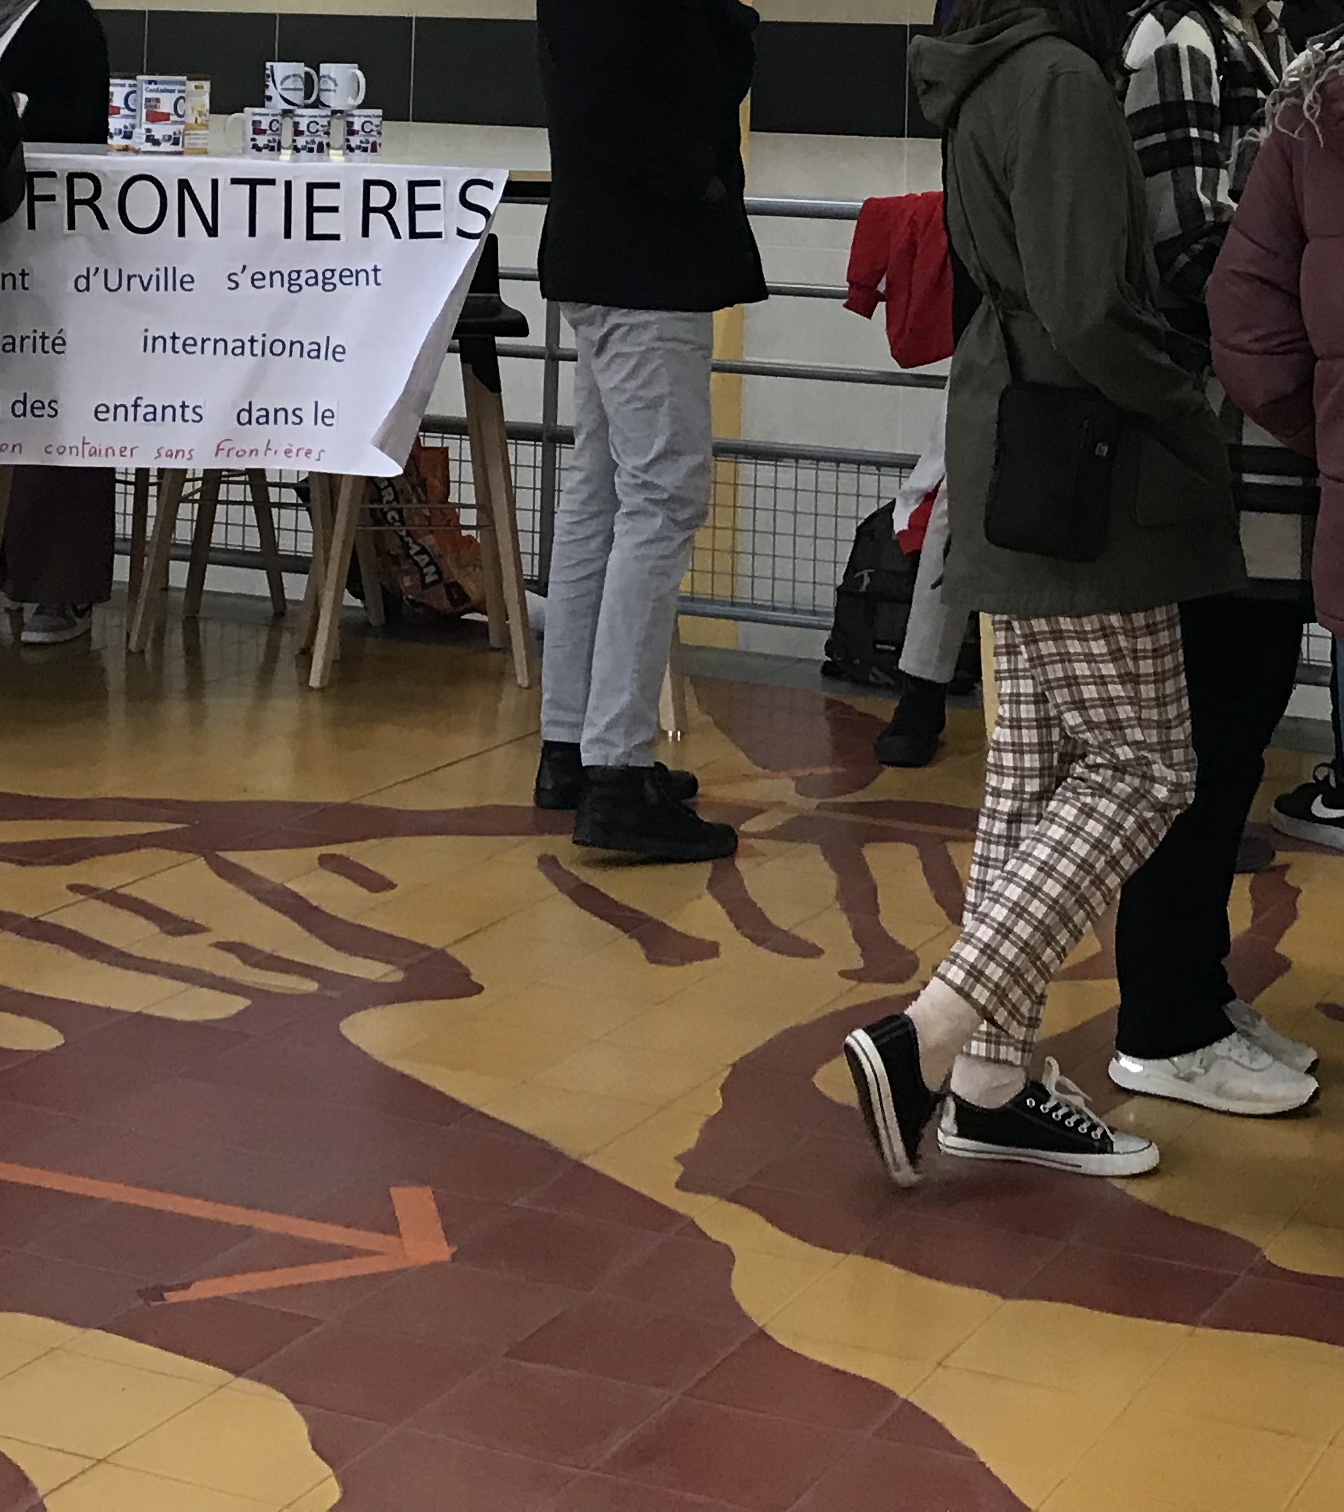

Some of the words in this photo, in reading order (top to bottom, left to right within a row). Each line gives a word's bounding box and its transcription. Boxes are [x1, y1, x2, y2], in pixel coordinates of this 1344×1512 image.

[26, 170, 494, 241] FRONTIERES
[143, 329, 347, 363] internationale
[11, 392, 59, 419] des
[93, 396, 204, 424] enfants
[236, 400, 304, 426] dans
[314, 400, 335, 427] le
[154, 444, 195, 461] sans
